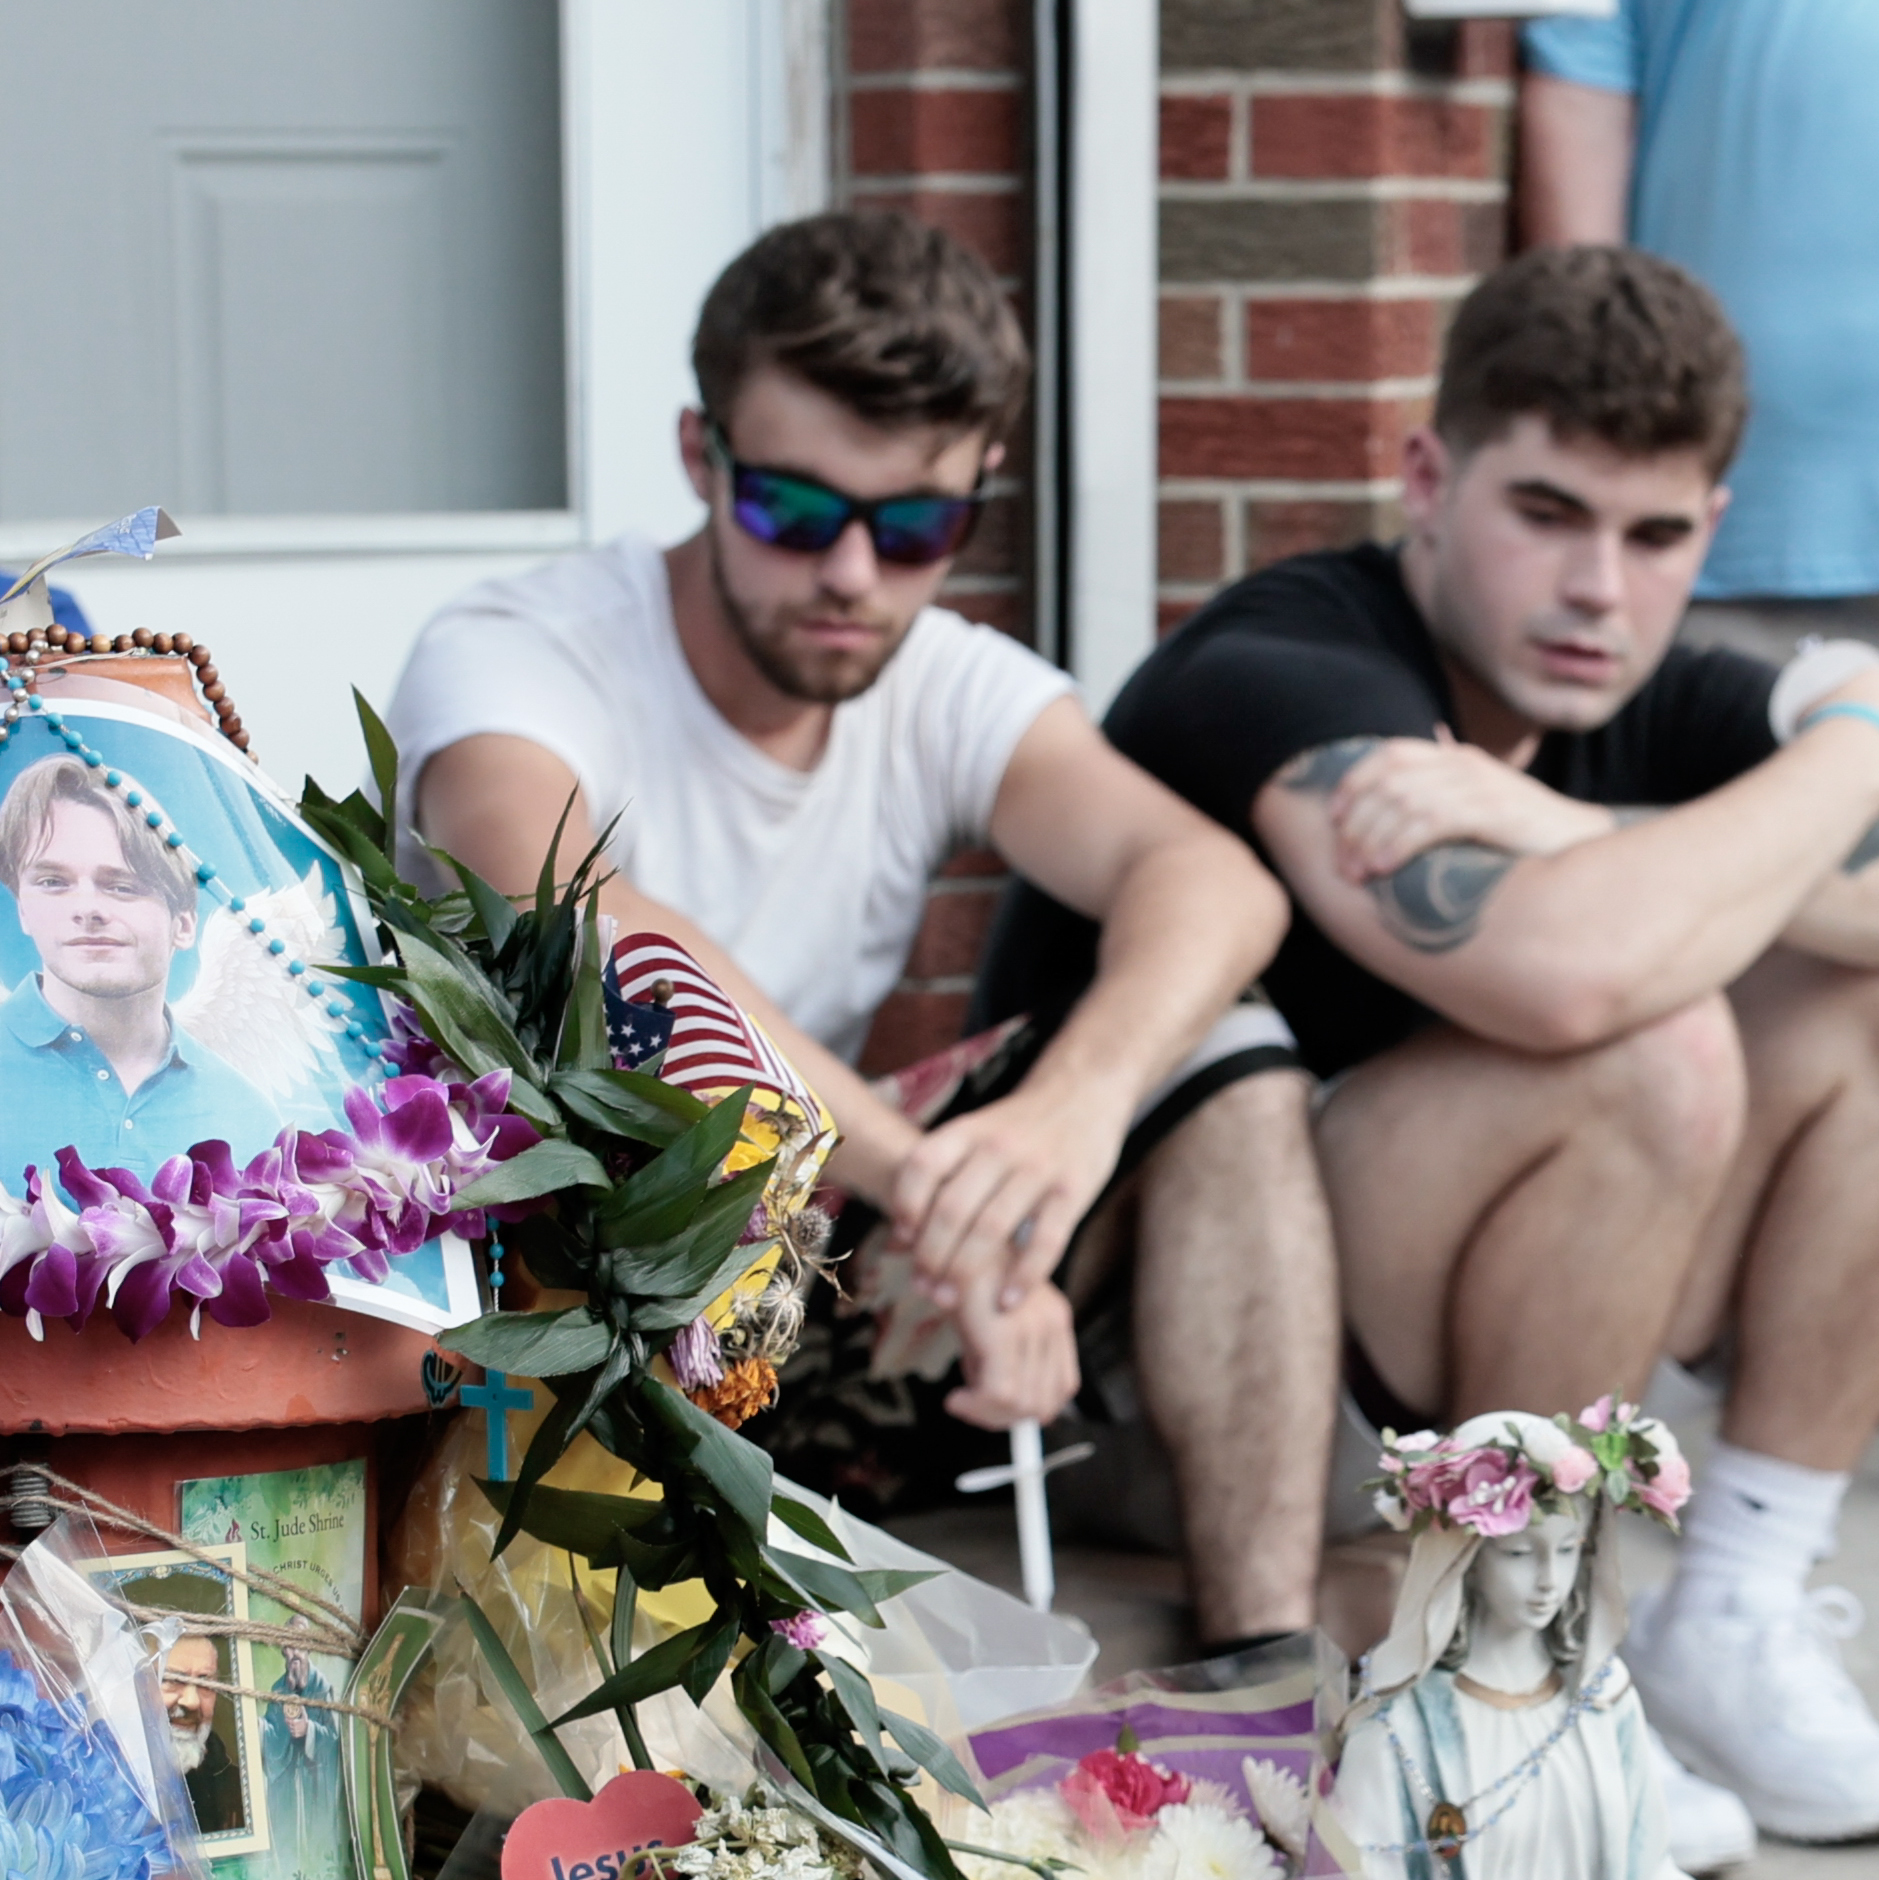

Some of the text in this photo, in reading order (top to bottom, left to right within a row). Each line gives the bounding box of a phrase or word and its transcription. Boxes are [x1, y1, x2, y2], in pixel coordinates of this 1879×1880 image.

[251, 1513, 344, 1542] St. Jude Shrine
[273, 1560, 340, 1602] CHRIST URGES US
